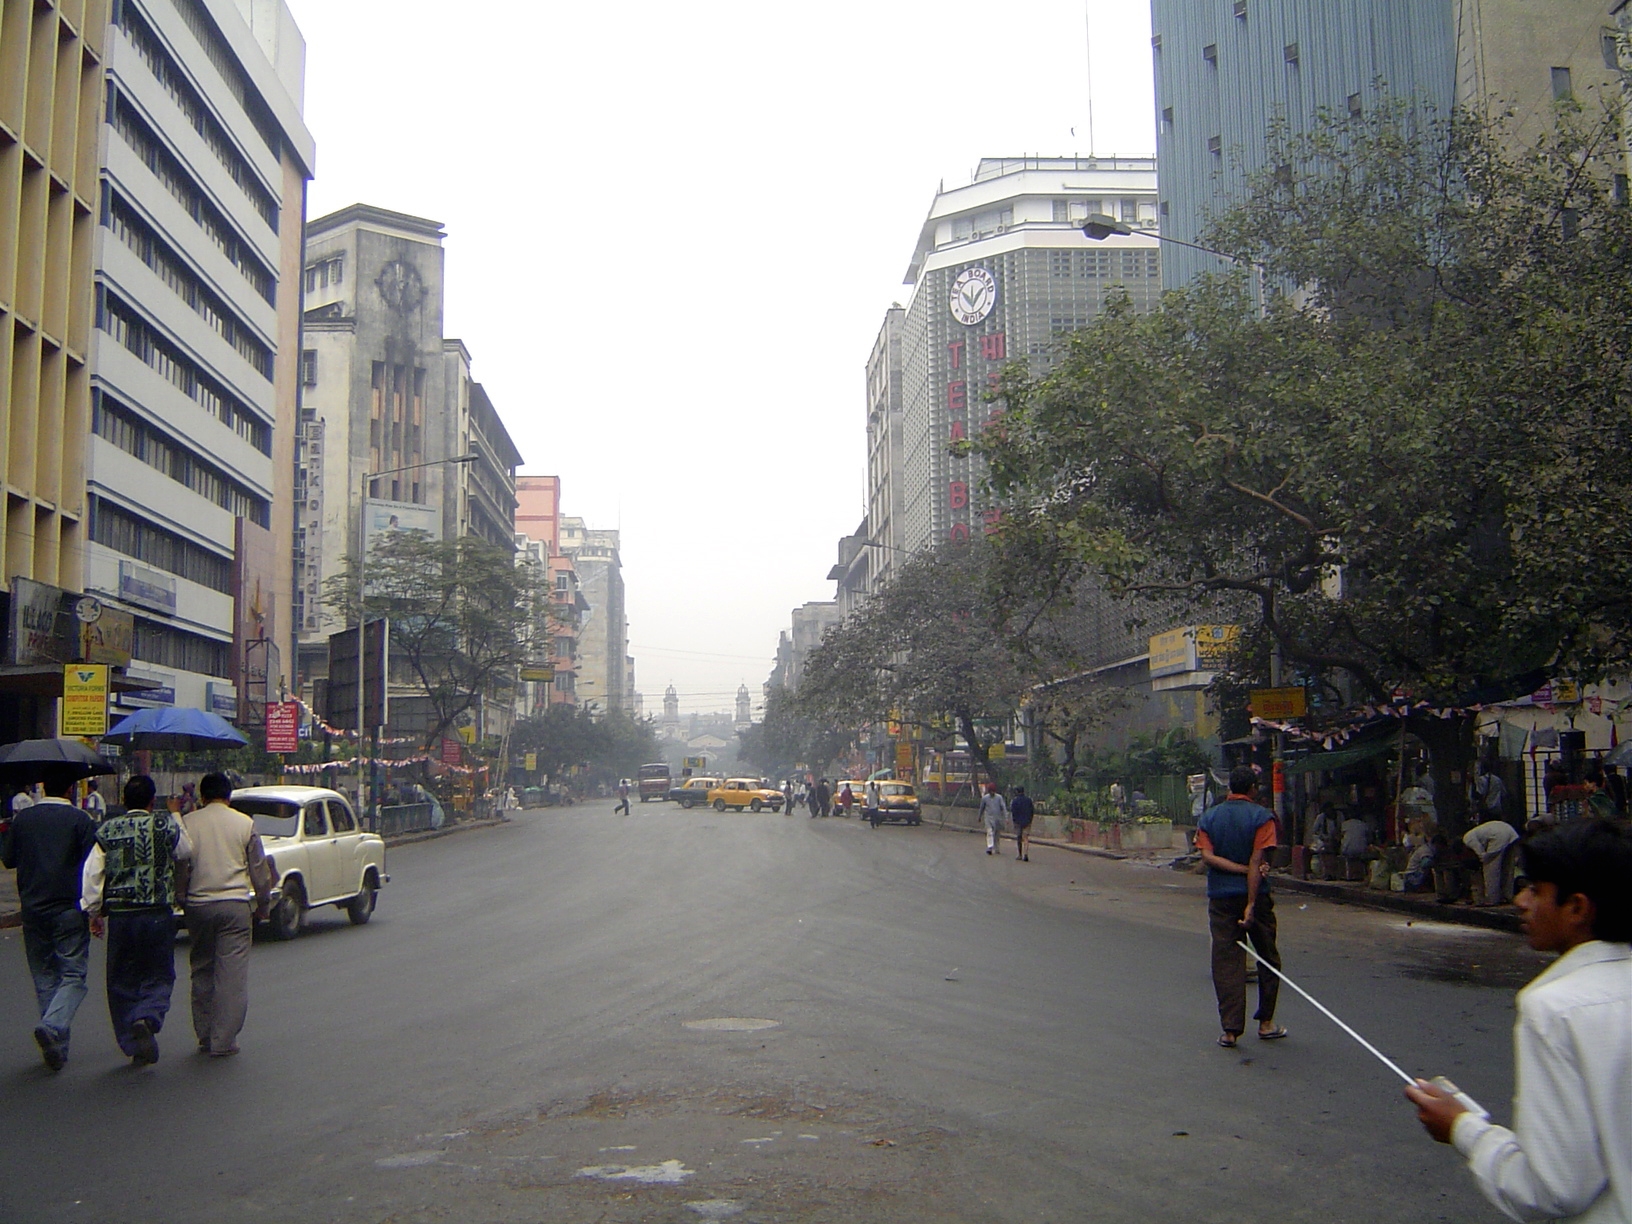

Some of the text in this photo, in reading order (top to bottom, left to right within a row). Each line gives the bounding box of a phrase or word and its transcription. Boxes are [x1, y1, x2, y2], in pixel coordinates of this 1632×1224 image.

[951, 269, 994, 302] TEA BOARD
[961, 311, 985, 323] INDIA
[947, 341, 966, 443] TEA
[309, 425, 321, 487] Bank
[306, 546, 318, 628] India
